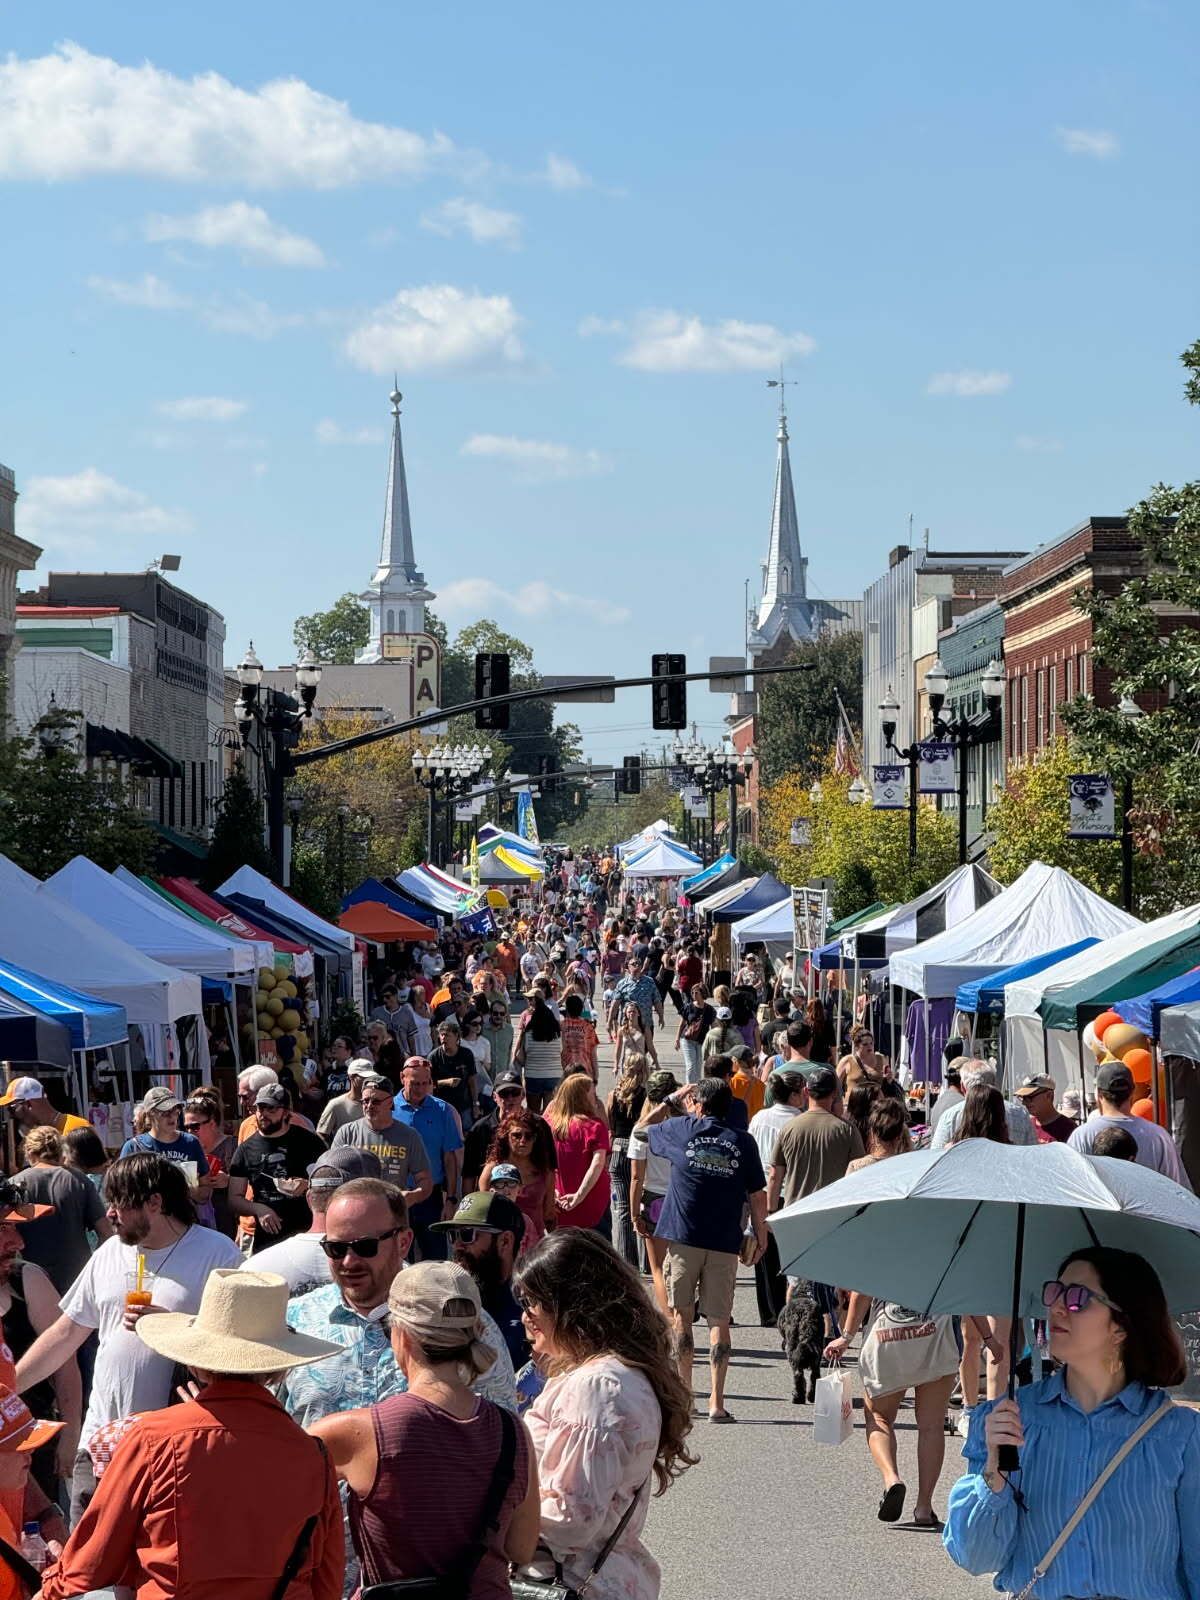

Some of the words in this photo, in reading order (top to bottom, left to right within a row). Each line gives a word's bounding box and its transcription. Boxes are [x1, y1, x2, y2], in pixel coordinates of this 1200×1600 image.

[687, 1136, 719, 1149] SALTY
[156, 1150, 188, 1162] RANDMA
[353, 1144, 406, 1159] RINES
